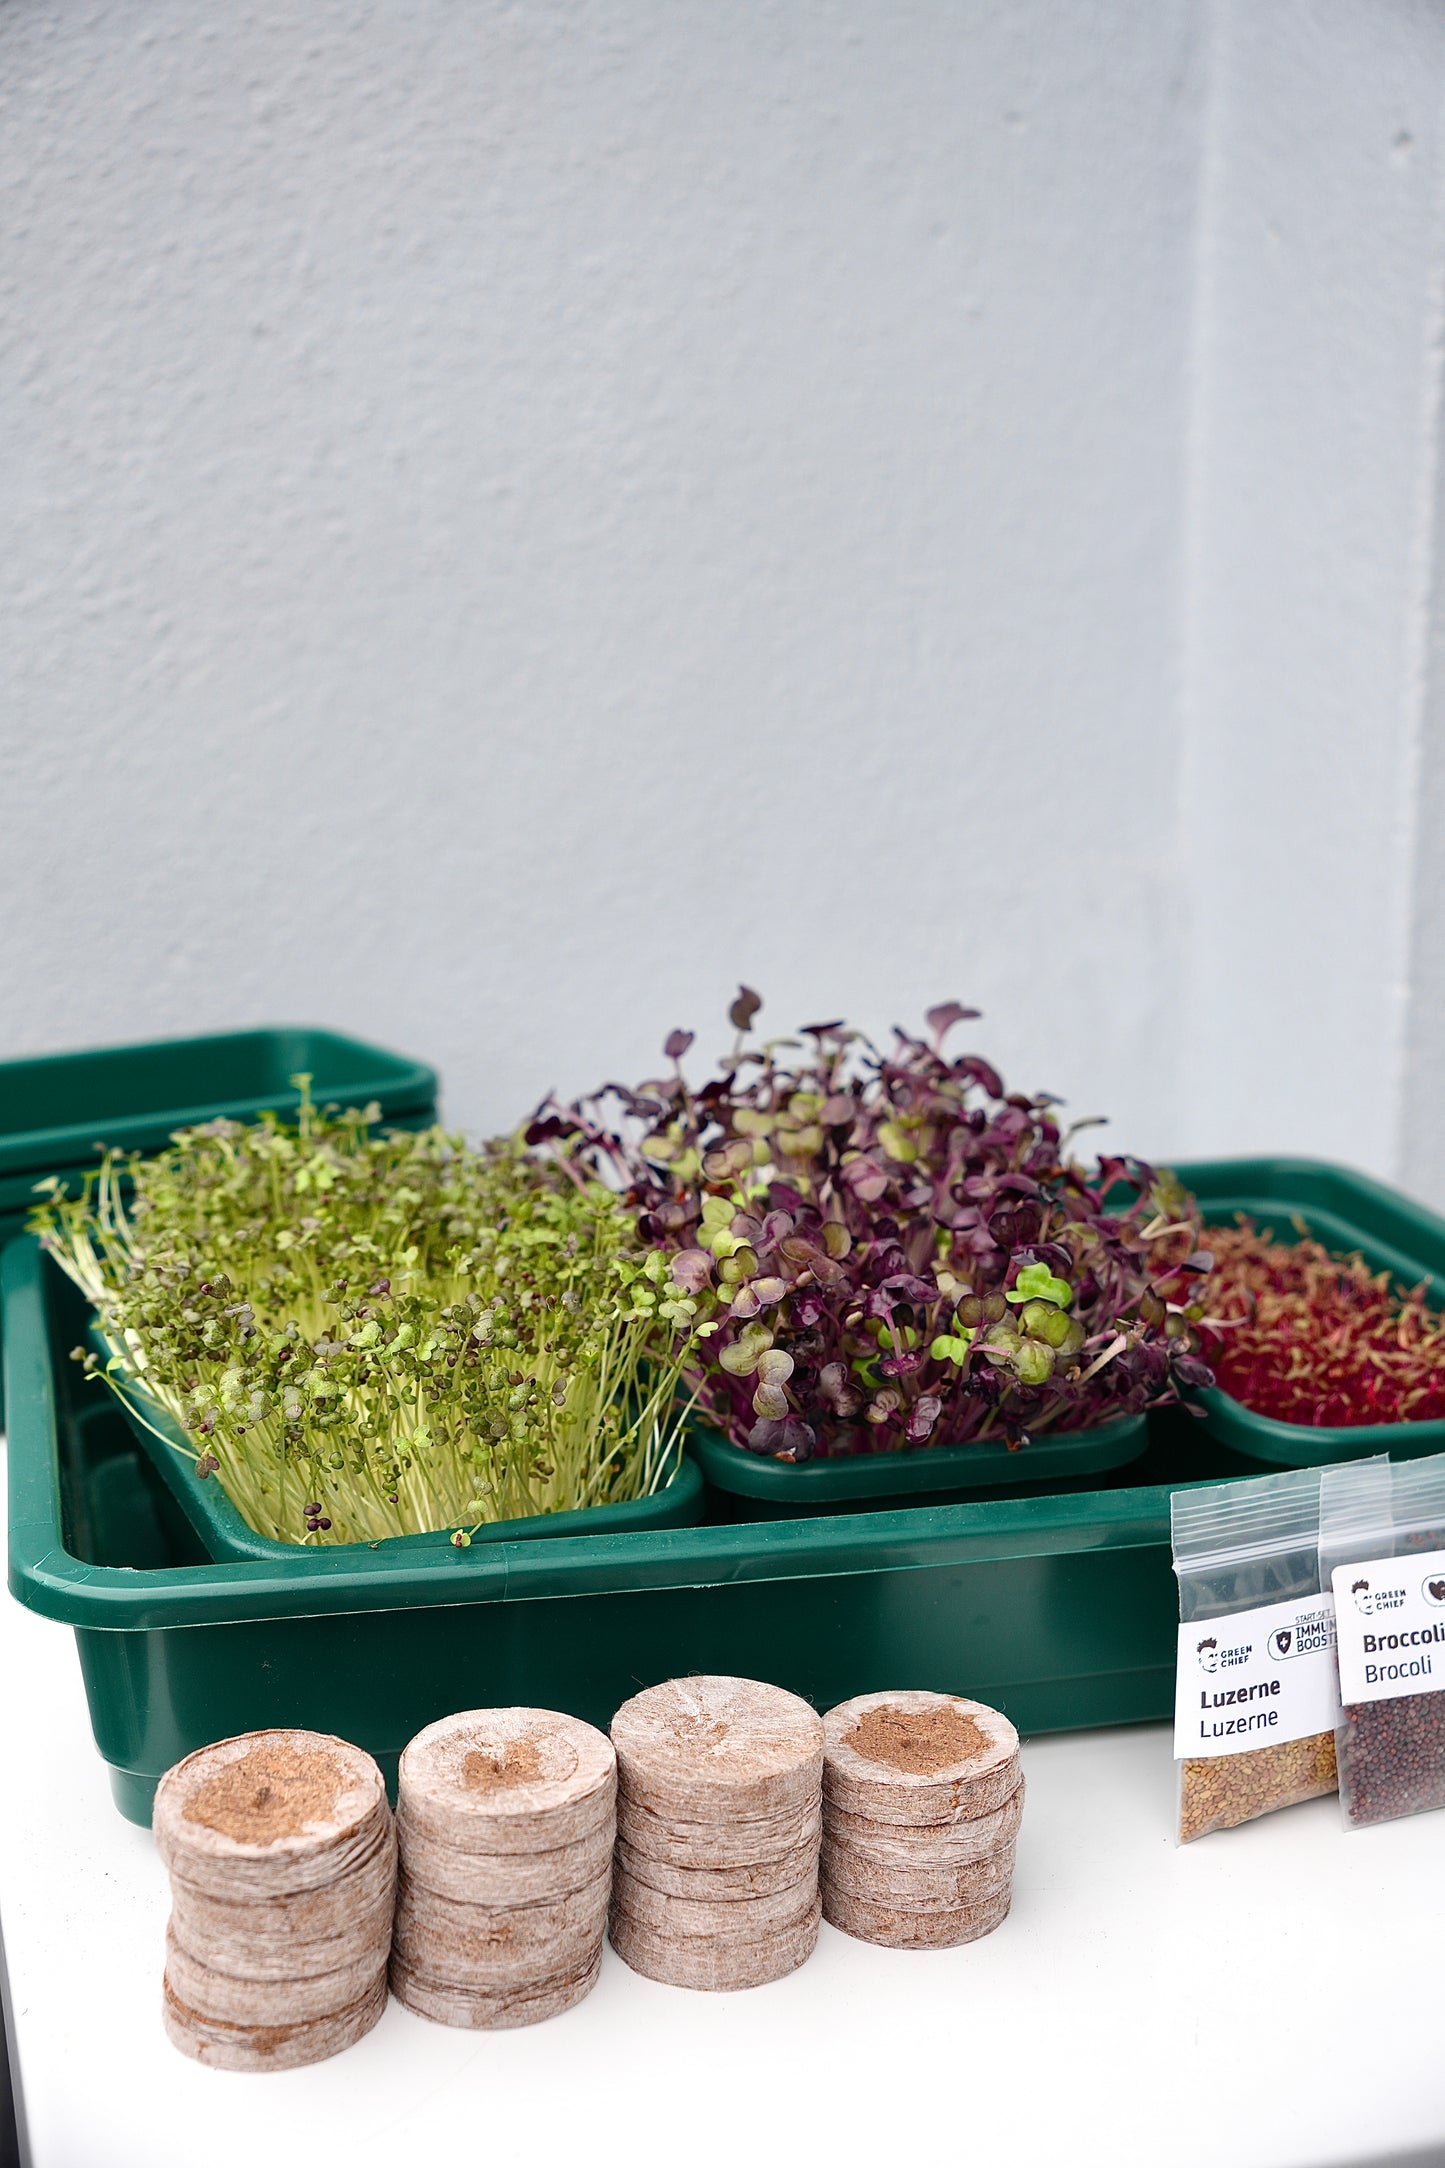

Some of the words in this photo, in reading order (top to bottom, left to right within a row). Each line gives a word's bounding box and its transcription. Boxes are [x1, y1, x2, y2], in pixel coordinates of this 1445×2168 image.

[1375, 1590, 1406, 1600] GREEN
[1376, 1599, 1405, 1610] CHIEF
[1297, 1633, 1337, 1652] BOOST
[1363, 1623, 1445, 1653] Broccoli
[1221, 1645, 1252, 1658] GREEN
[1221, 1655, 1249, 1668] CHIEF
[1365, 1655, 1432, 1683] Brocoli
[1201, 1680, 1280, 1709] Luzerne
[1200, 1711, 1278, 1738] Luzerne
